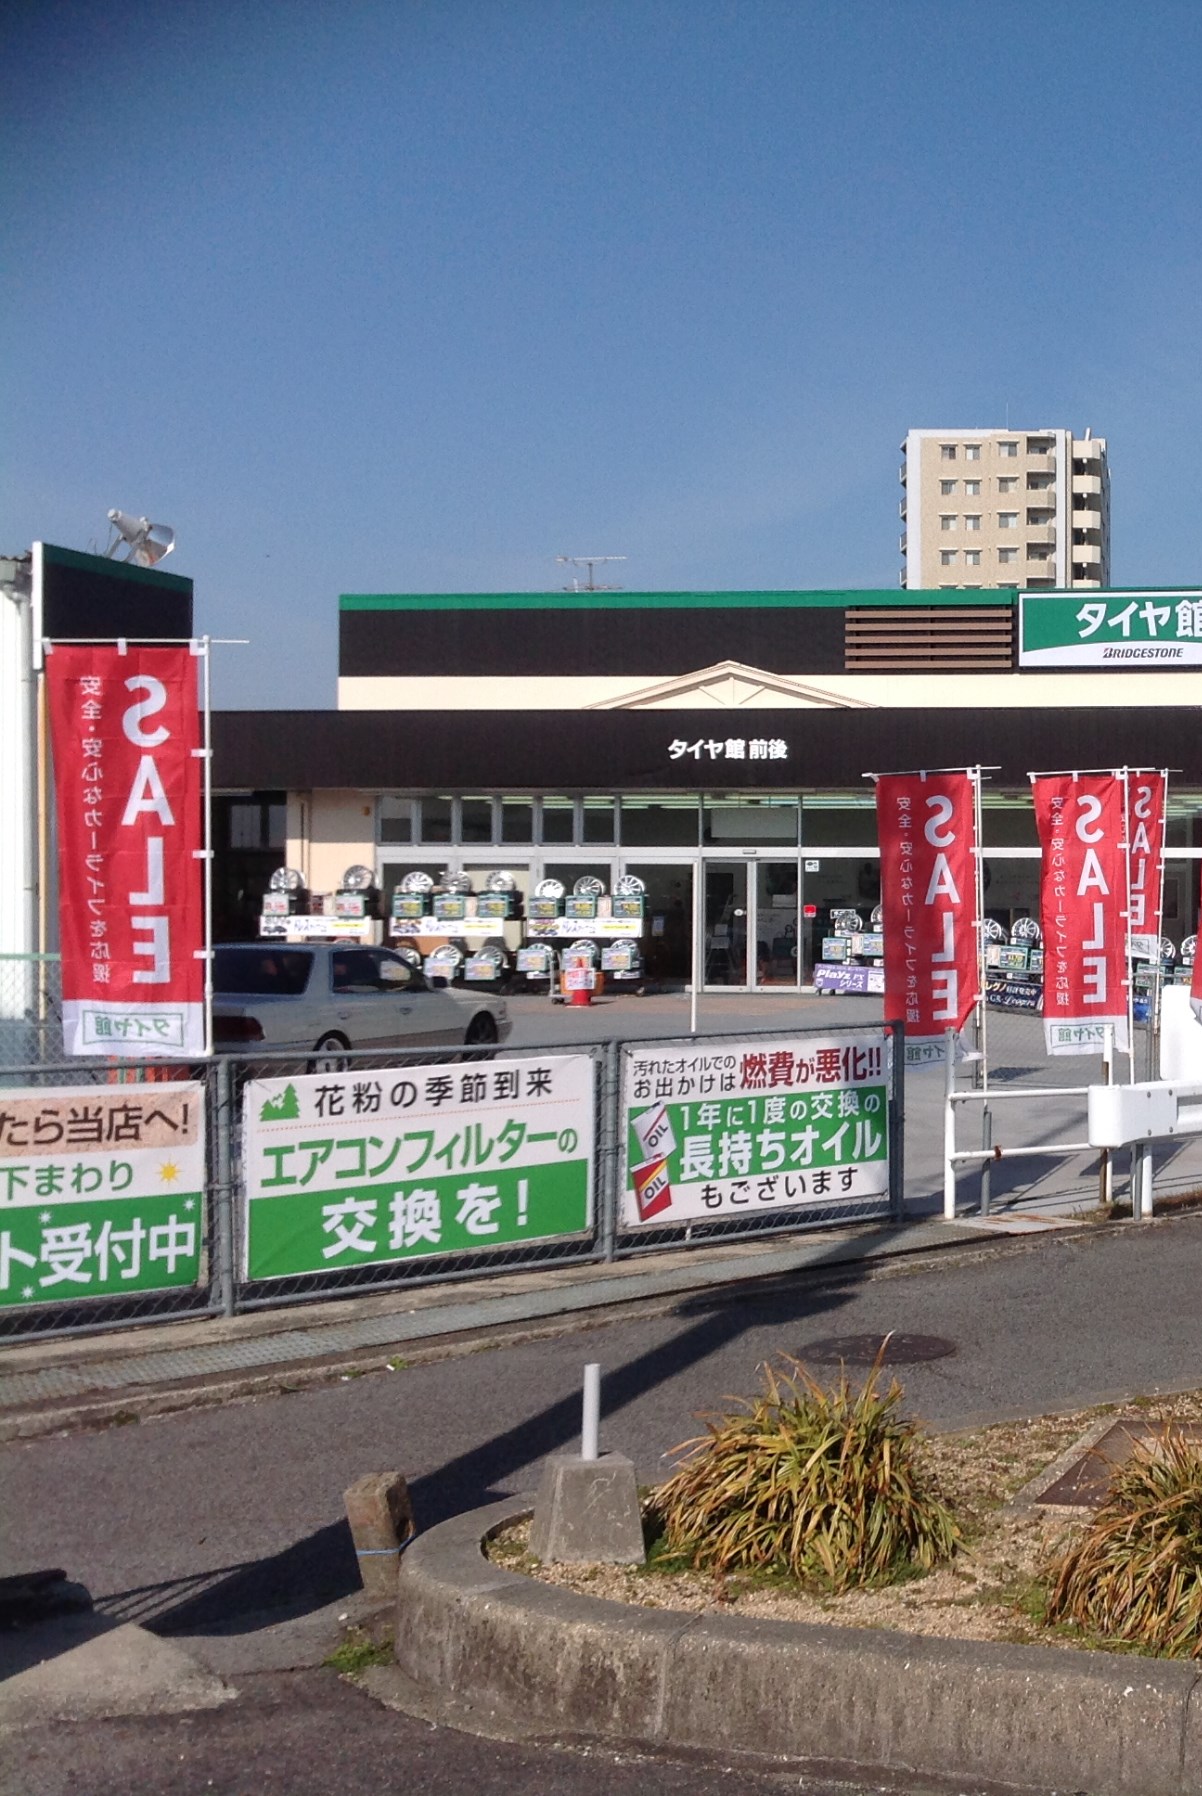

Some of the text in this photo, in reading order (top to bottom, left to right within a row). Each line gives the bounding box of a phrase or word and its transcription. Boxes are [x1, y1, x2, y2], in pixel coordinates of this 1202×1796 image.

[1102, 646, 1184, 660] BRIDGESTONE
[667, 738, 788, 760] タイヤ館 前後
[632, 1055, 737, 1075] 汚れたオイルでの
[739, 1045, 881, 1090] 燃費が悪化!!
[314, 1067, 553, 1118] 花粉の季節到来
[633, 1072, 736, 1099] お出かけは
[680, 1092, 880, 1131] 1年に1度の交換の
[260, 1119, 578, 1189] エアコンフィルターの
[647, 1122, 669, 1148] OIL
[679, 1119, 882, 1182] 長持ちオイル
[0, 1160, 134, 1200] 下まわり
[643, 1174, 668, 1201] OIL
[700, 1166, 859, 1210] もございます
[321, 1179, 529, 1260] 交換を!
